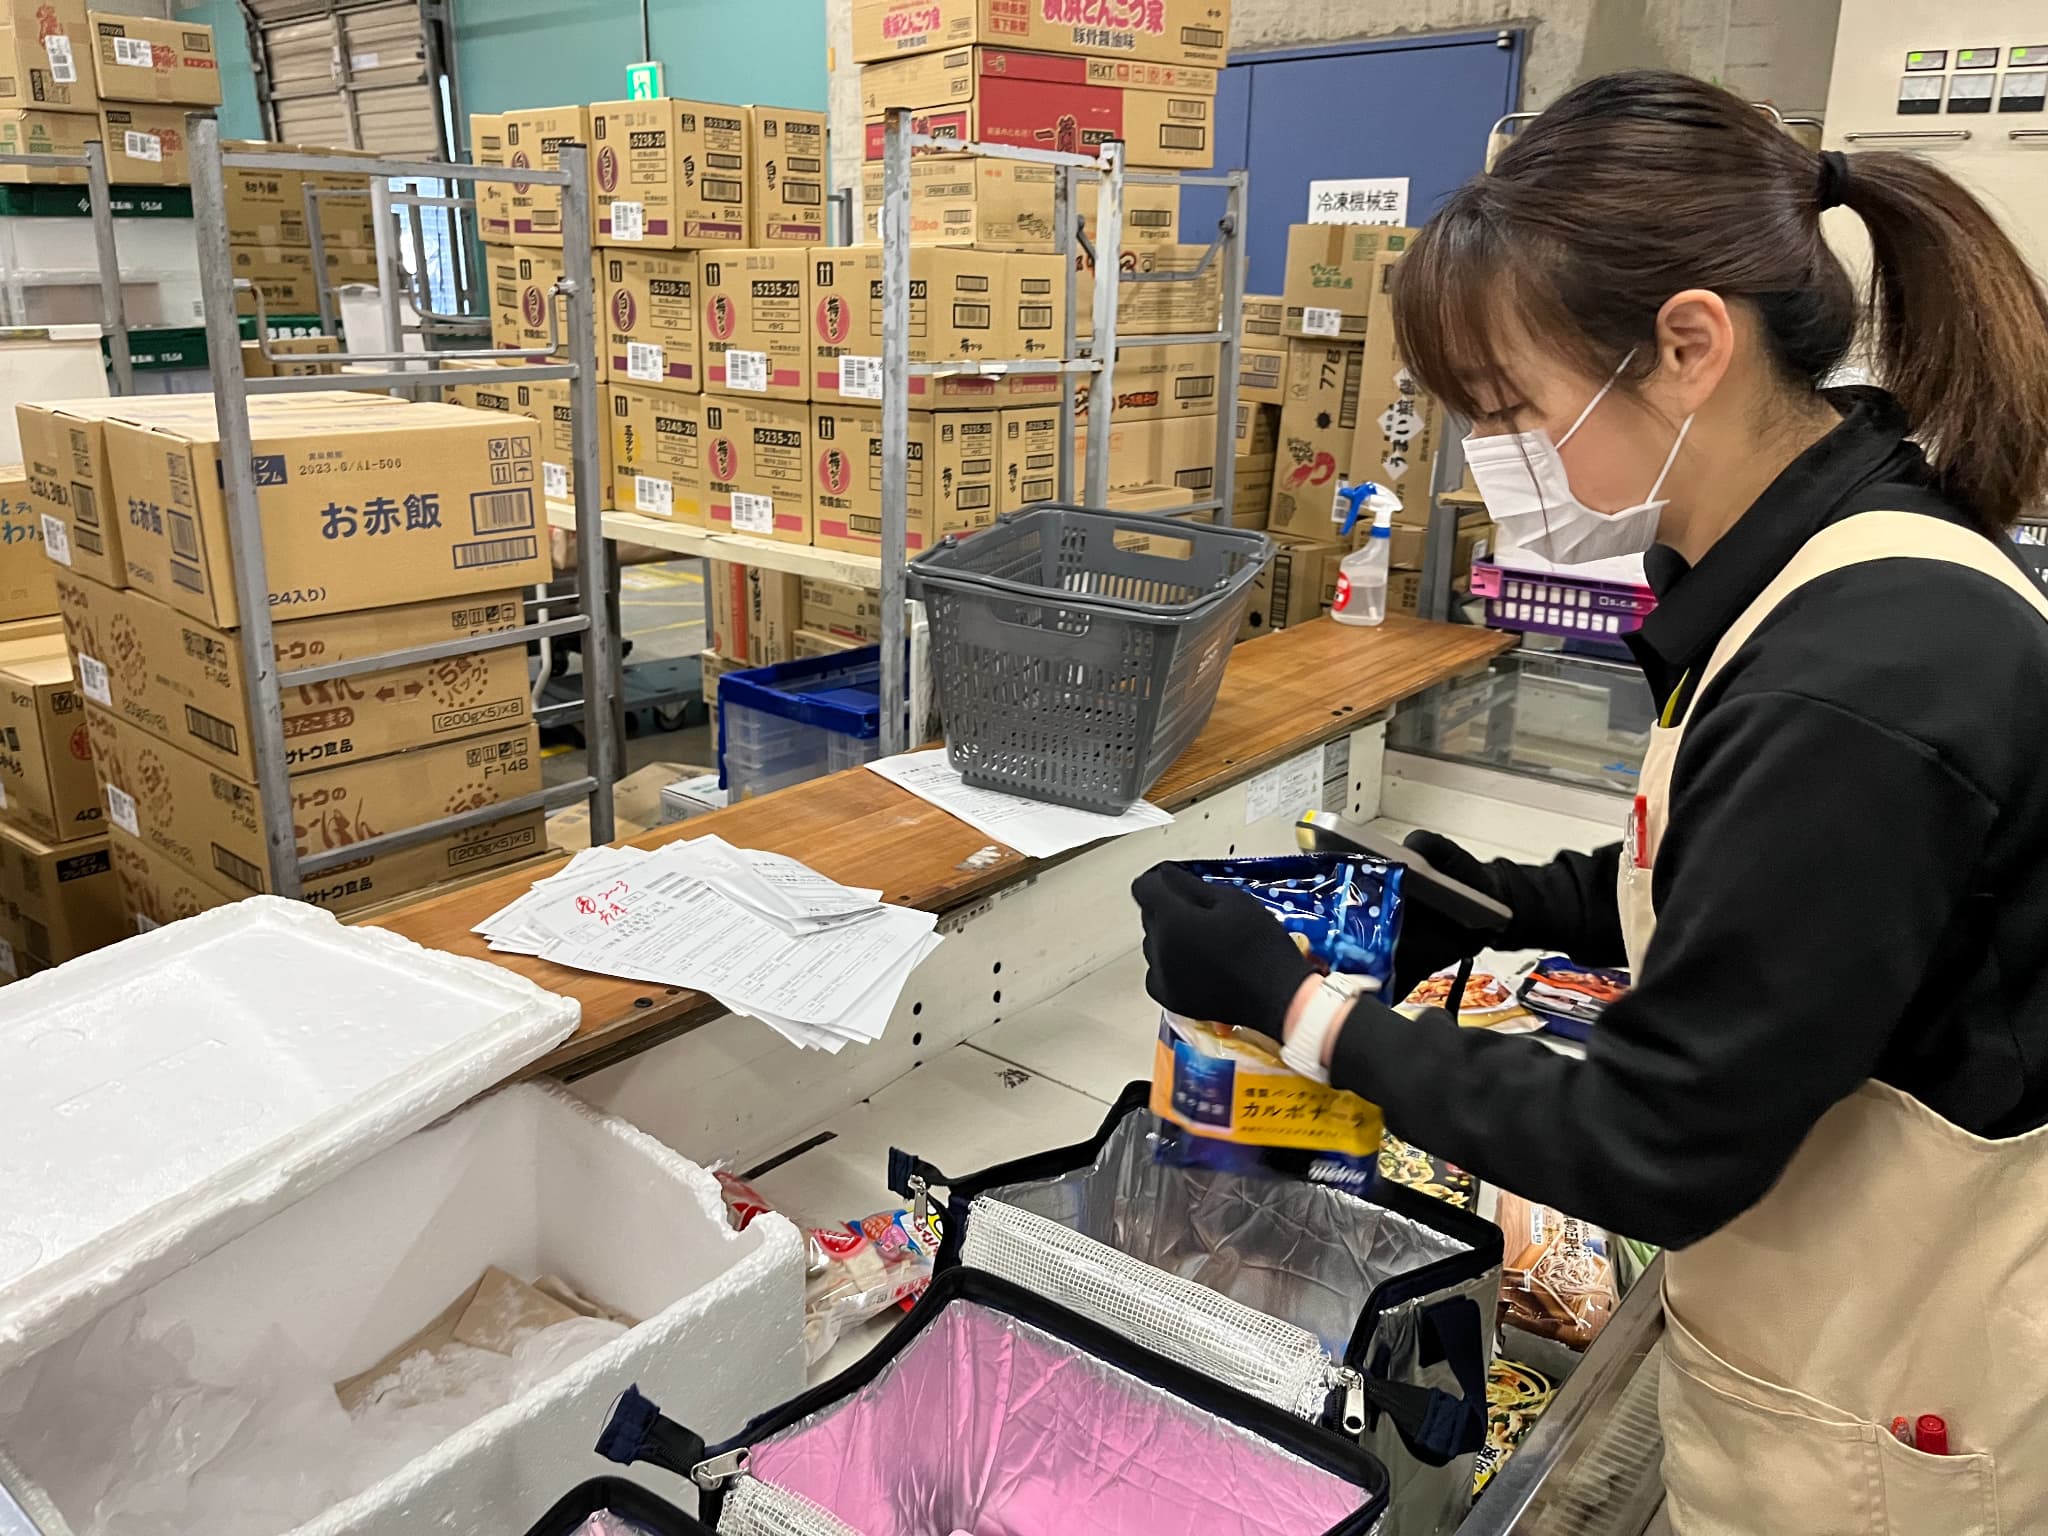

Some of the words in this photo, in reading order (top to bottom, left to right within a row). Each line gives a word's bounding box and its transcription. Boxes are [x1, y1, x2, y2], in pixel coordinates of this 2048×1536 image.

[1317, 190, 1399, 213] 冷凍機械室
[321, 493, 442, 539] お赤飯
[484, 758, 529, 779] F-148
